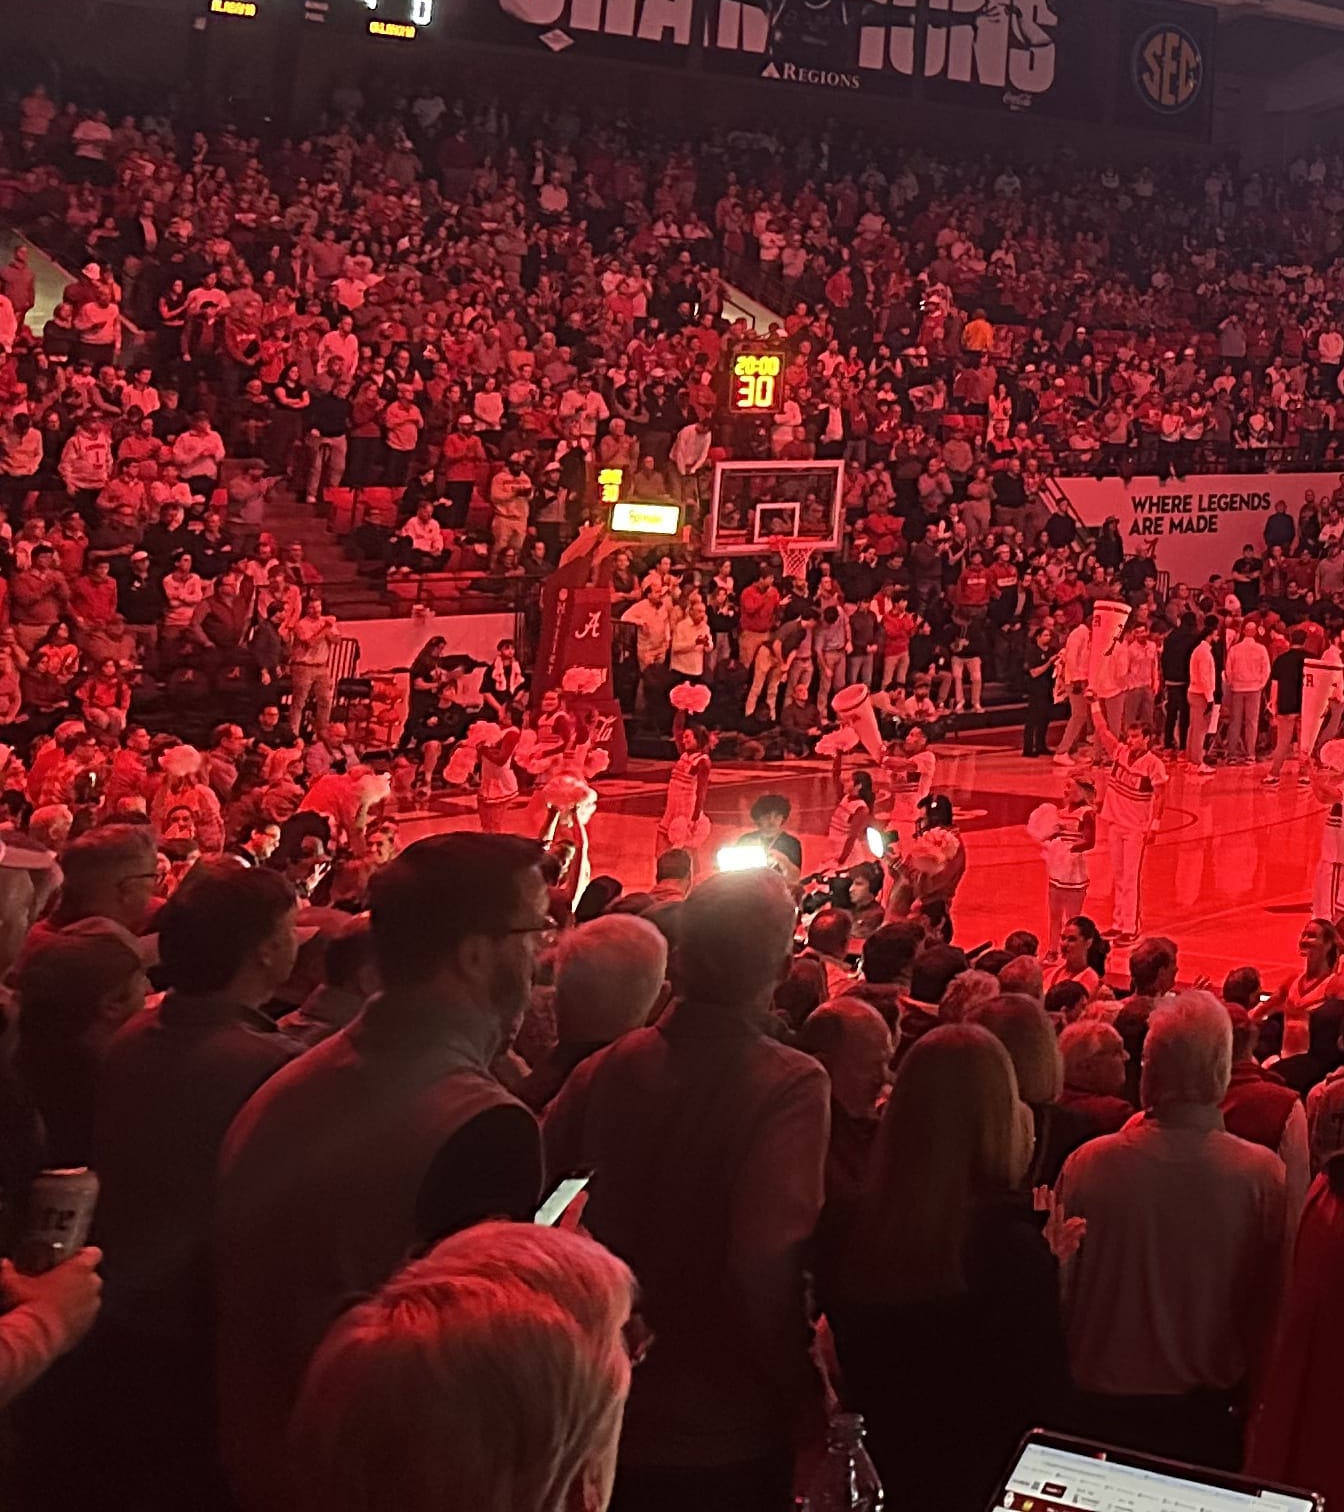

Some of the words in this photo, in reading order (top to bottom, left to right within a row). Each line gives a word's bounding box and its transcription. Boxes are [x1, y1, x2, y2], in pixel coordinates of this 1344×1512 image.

[783, 62, 860, 88] REGIONS
[1140, 31, 1200, 108] SEC
[734, 355, 782, 376] 20:00
[737, 376, 773, 408] 30
[1132, 494, 1192, 514] WHERE
[1198, 492, 1270, 512] LEGENDS
[1129, 516, 1163, 536] ARE
[1169, 515, 1218, 534] MADE
